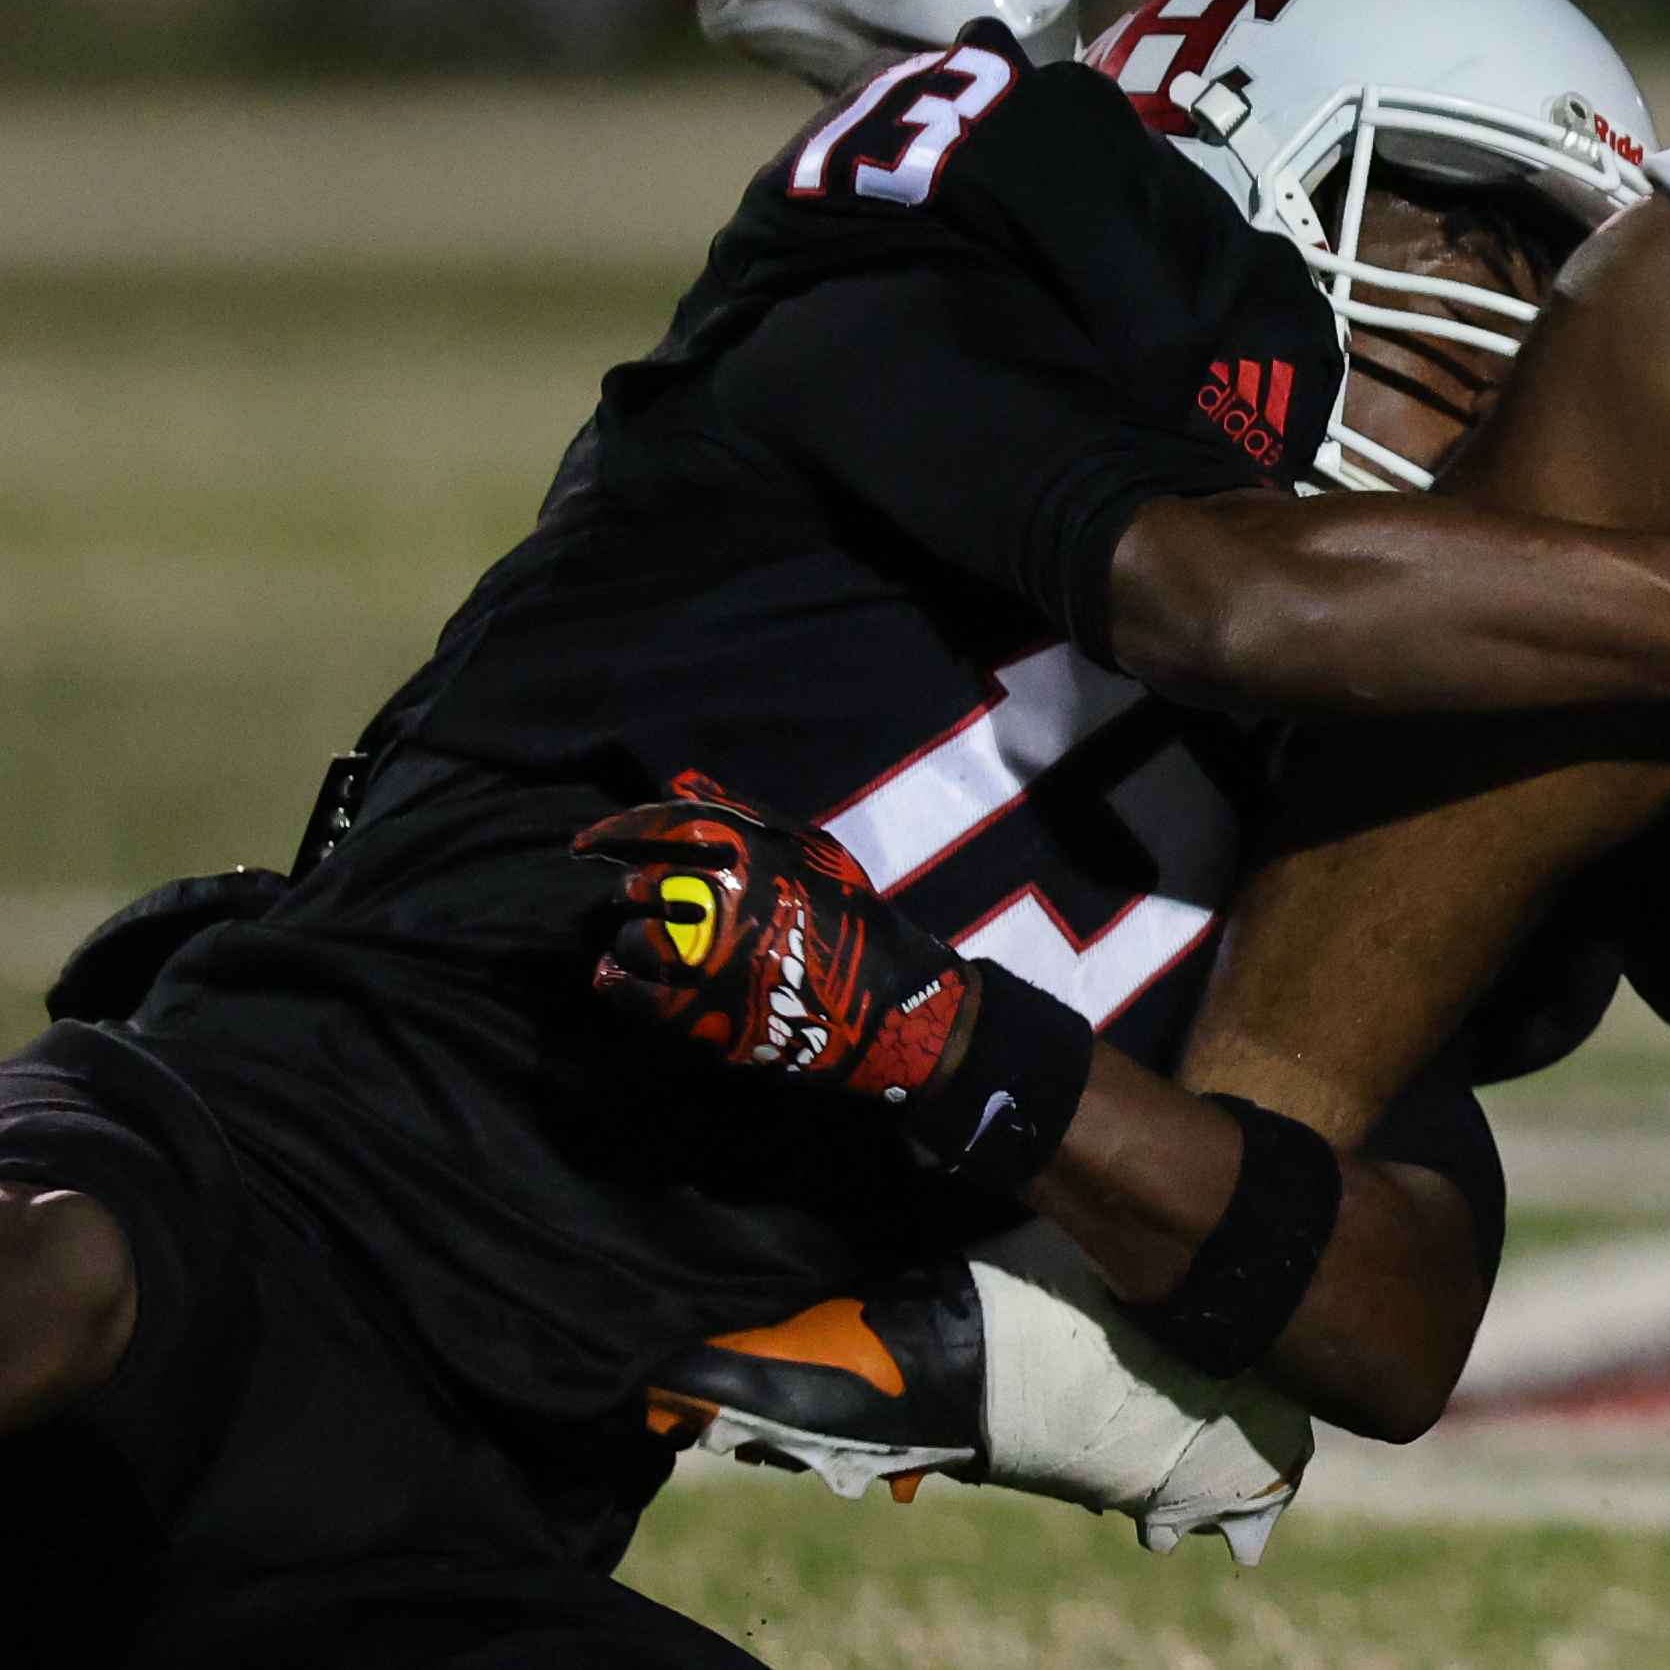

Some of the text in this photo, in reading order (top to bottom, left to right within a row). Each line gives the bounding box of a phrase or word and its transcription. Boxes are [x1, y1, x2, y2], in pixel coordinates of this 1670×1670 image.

[788, 44, 1019, 206] 13
[1594, 112, 1644, 167] Ridd
[1197, 385, 1285, 466] didas
